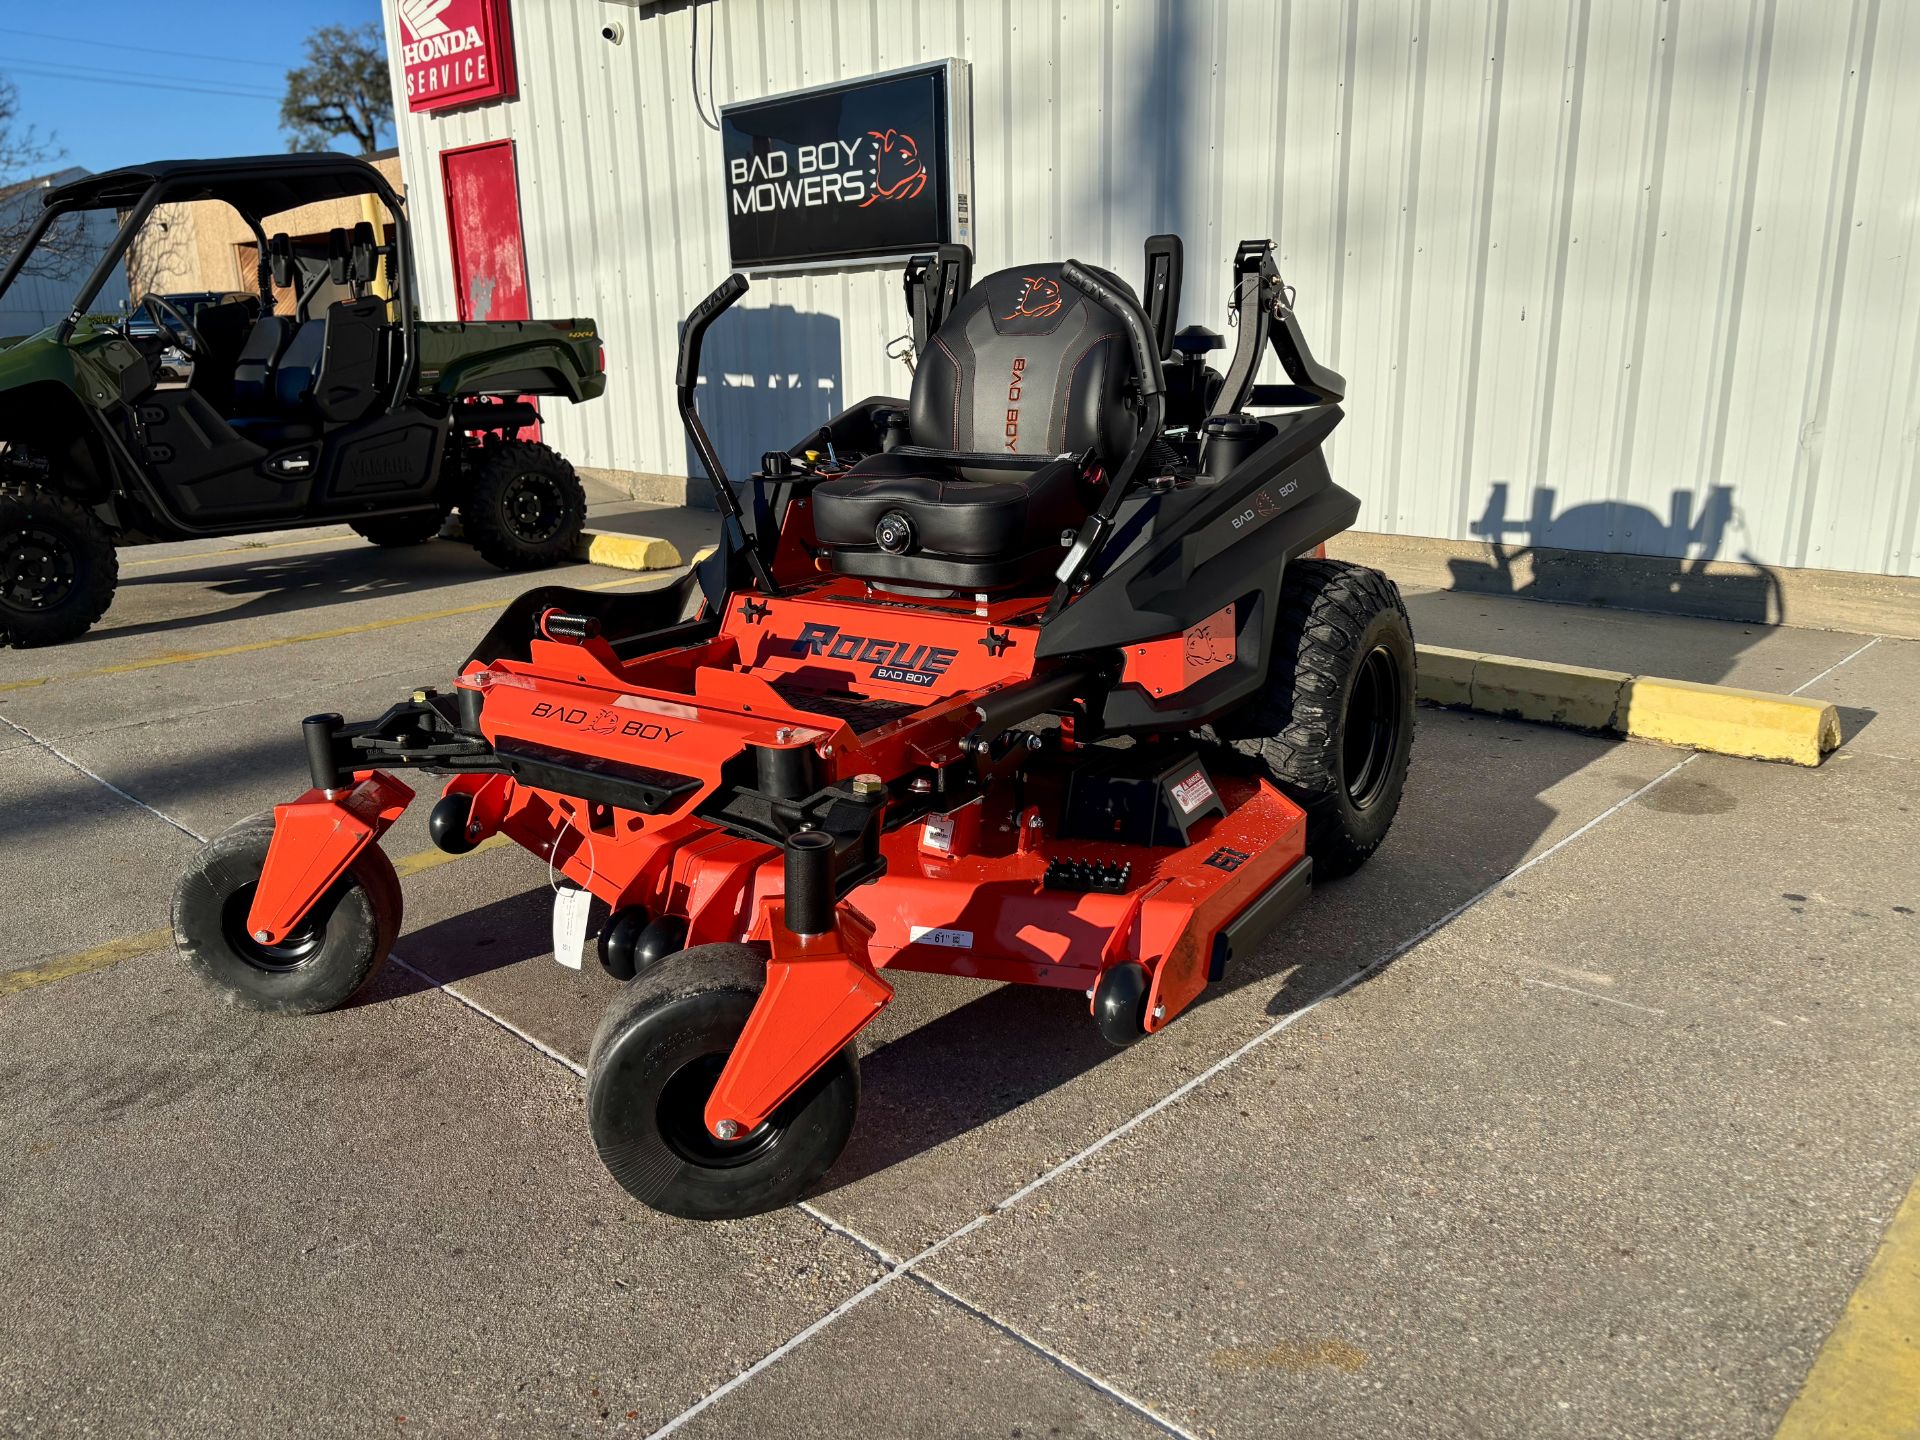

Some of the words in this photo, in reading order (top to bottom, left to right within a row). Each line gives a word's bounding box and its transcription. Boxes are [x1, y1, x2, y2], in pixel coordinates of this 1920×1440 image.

[403, 26, 483, 66] HONDA
[407, 55, 486, 96] SERVICE
[730, 150, 787, 184] BAD
[798, 137, 863, 173] BOY
[732, 170, 865, 215] MOWERS
[1008, 358, 1026, 402] BAD
[1005, 409, 1019, 453] BOY
[1231, 509, 1255, 529] BAD
[1279, 478, 1298, 497] BOY
[791, 621, 960, 675] ROGUE
[877, 668, 903, 681] BAD
[905, 673, 932, 684] BOY
[531, 702, 588, 724] BAD
[621, 720, 684, 743] BOY
[934, 933, 950, 943] 61"
